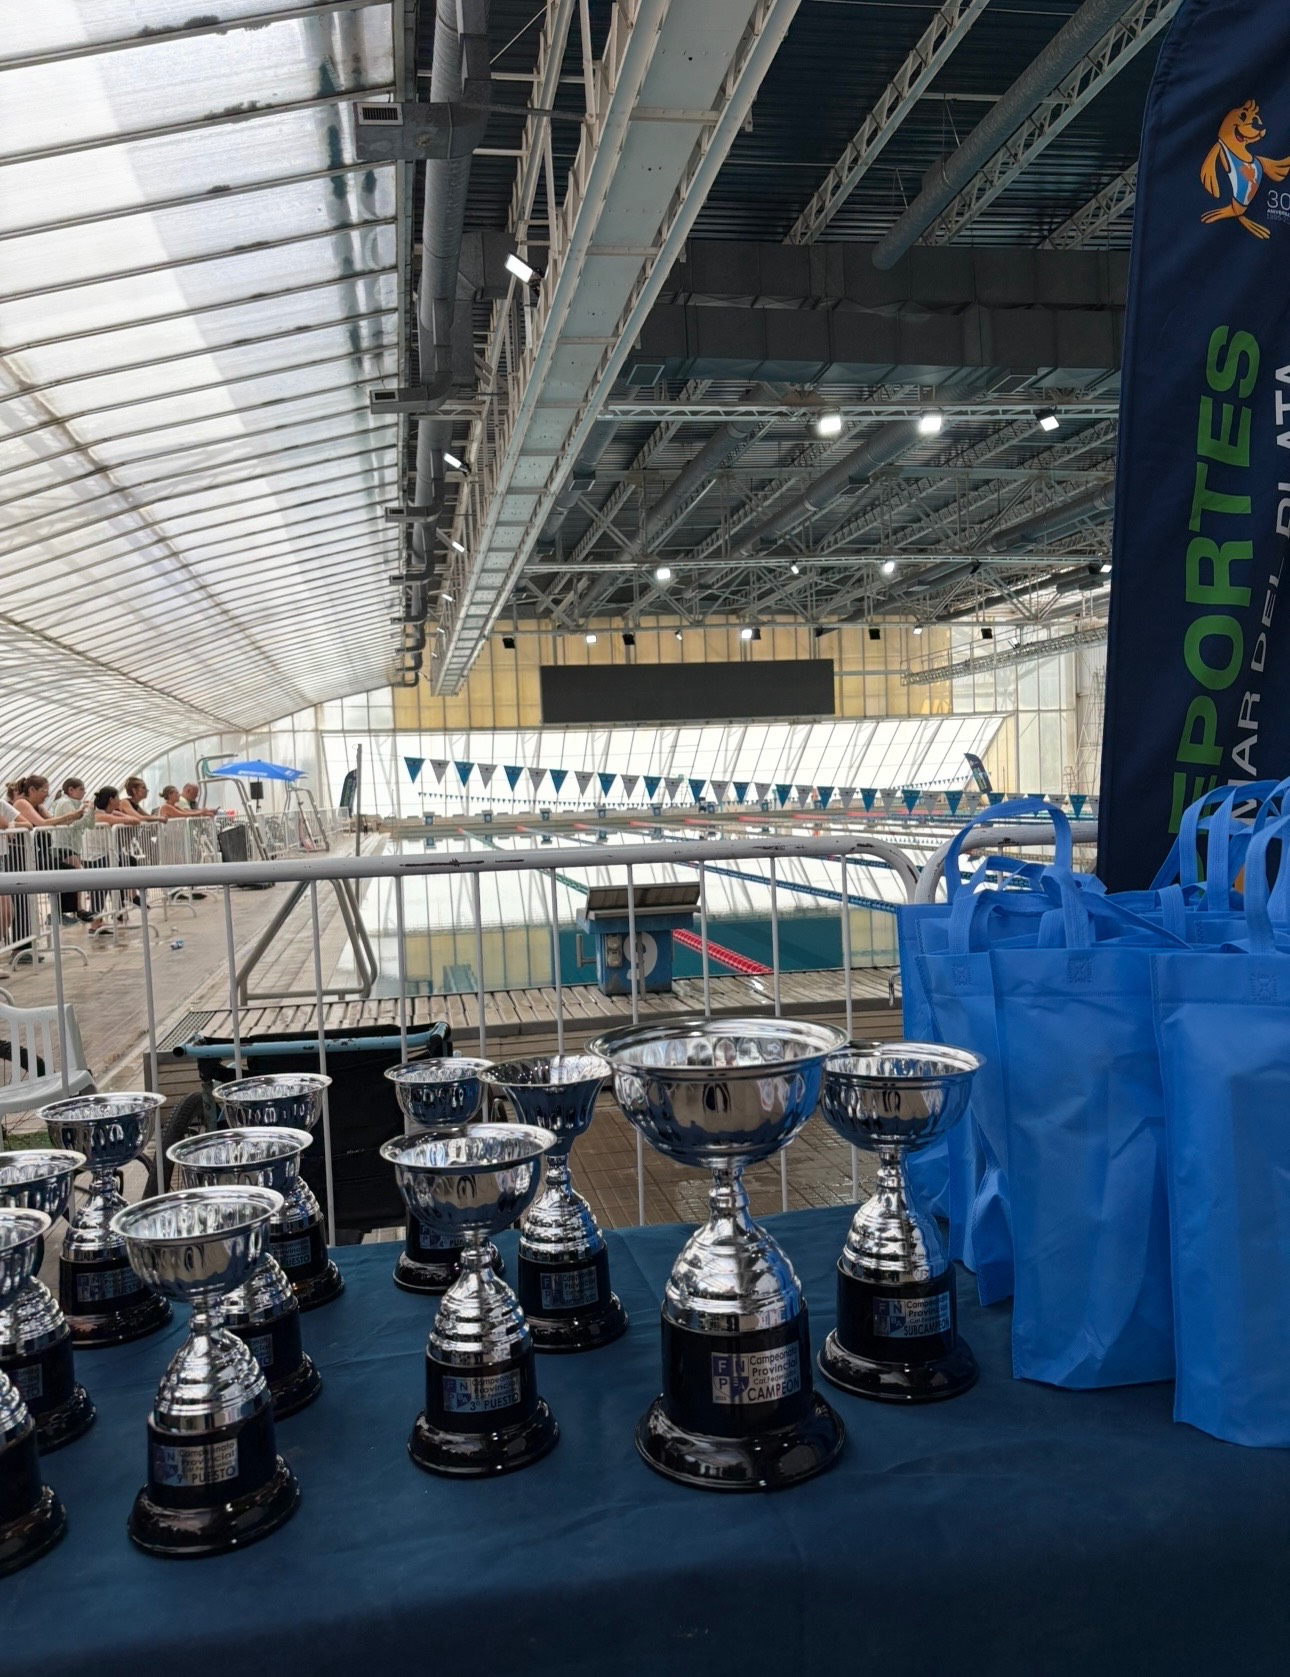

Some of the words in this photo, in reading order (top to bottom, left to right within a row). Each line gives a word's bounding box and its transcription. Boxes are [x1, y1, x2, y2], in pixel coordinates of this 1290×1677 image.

[1267, 189, 1290, 210] 30
[1168, 324, 1261, 895] EPORTES
[623, 931, 658, 980] 9
[752, 1357, 798, 1377] Provincial
[747, 1375, 800, 1402] CAMPEON
[179, 1441, 235, 1457] Campnato
[181, 1449, 235, 1466] Provcial
